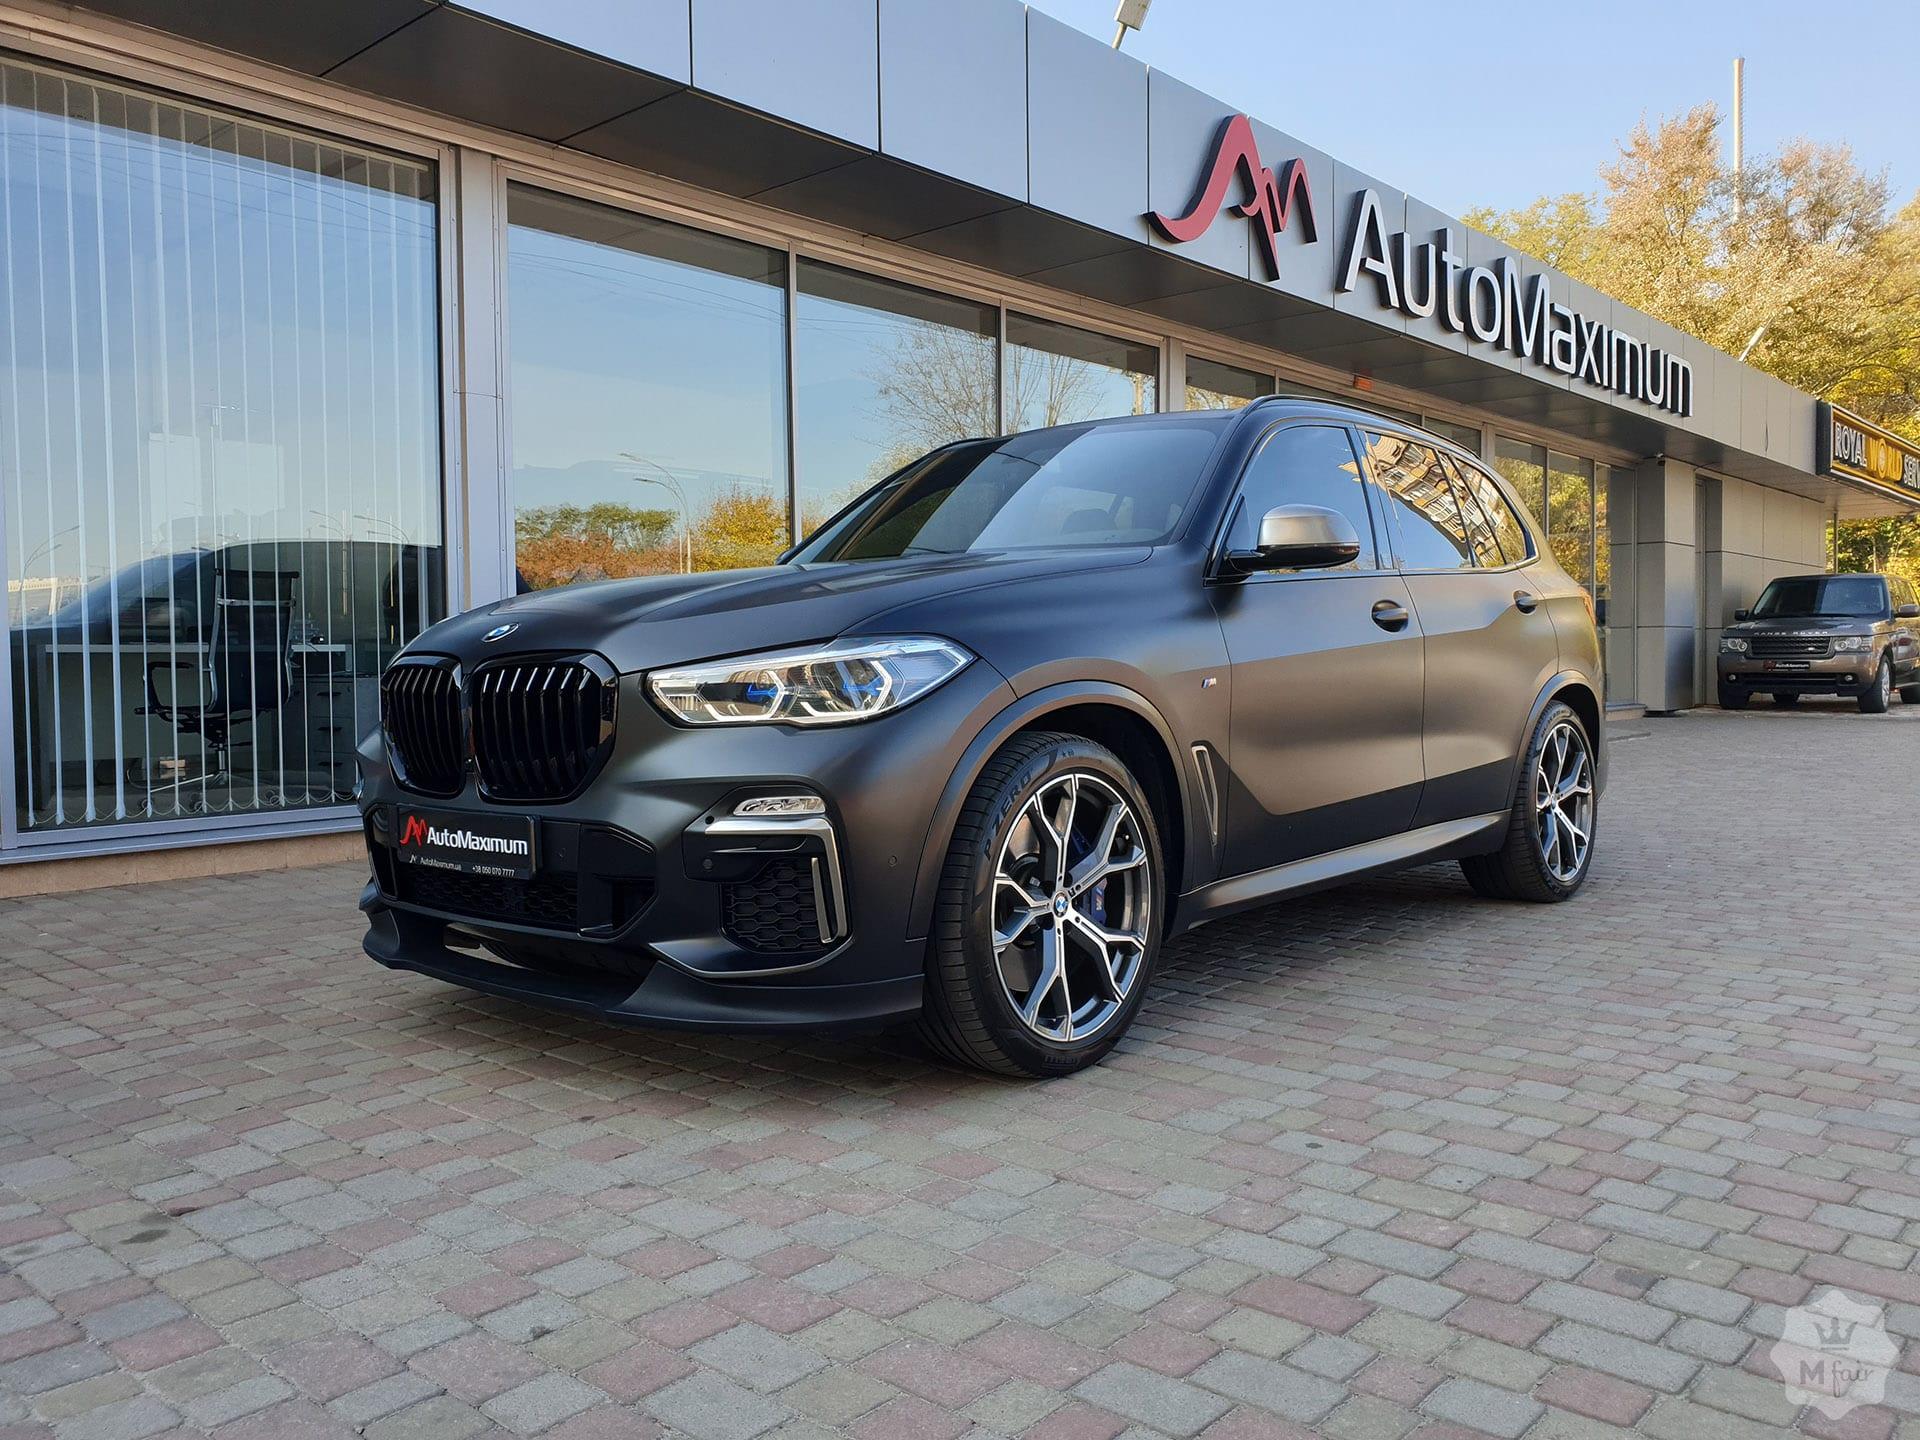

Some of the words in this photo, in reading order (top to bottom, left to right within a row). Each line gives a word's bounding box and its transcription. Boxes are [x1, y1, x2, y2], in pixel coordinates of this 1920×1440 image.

[1336, 189, 1694, 417] AutoMaximum
[1834, 421, 1867, 468] ROYAL
[427, 827, 528, 855] AutoMaximum
